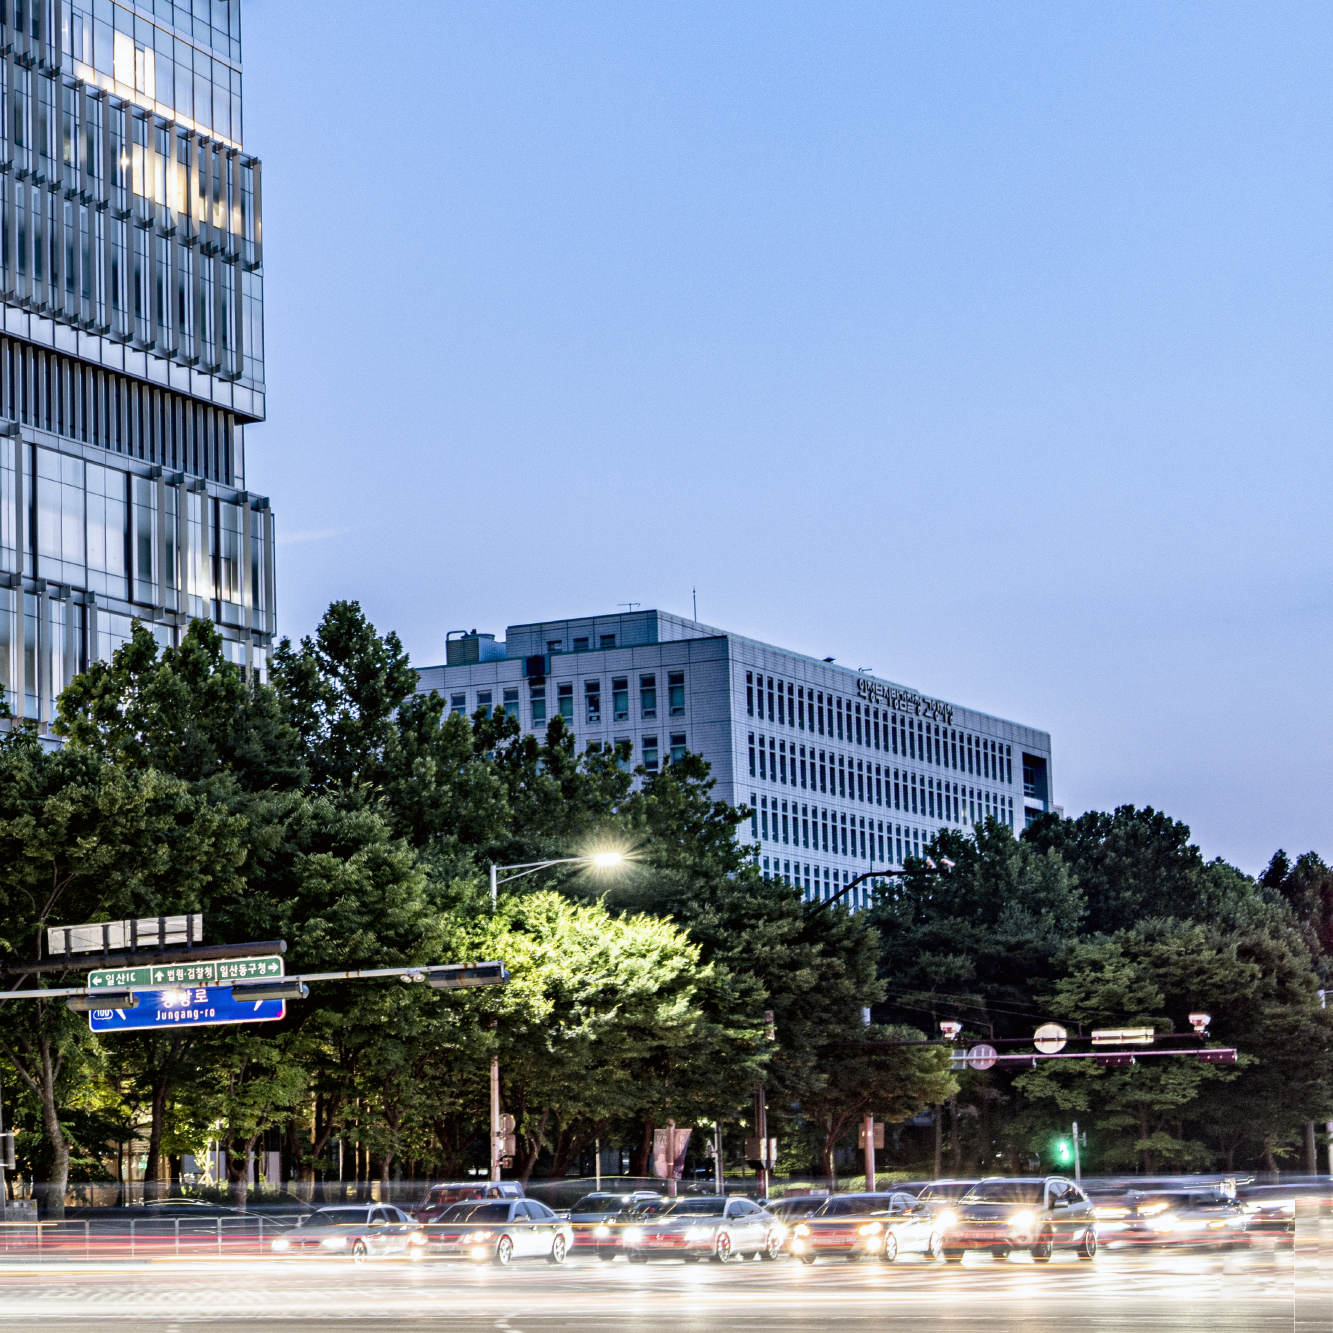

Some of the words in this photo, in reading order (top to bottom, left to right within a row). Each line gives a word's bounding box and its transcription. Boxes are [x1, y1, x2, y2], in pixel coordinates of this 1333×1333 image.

[857, 678, 922, 716] 의정부지방검찰청
[923, 698, 953, 725] 고양지청
[167, 966, 213, 982] 법원·검찰청
[219, 962, 267, 978] 일산동구청
[105, 972, 136, 986] 일산IC
[155, 1009, 215, 1021] Jungang-ro
